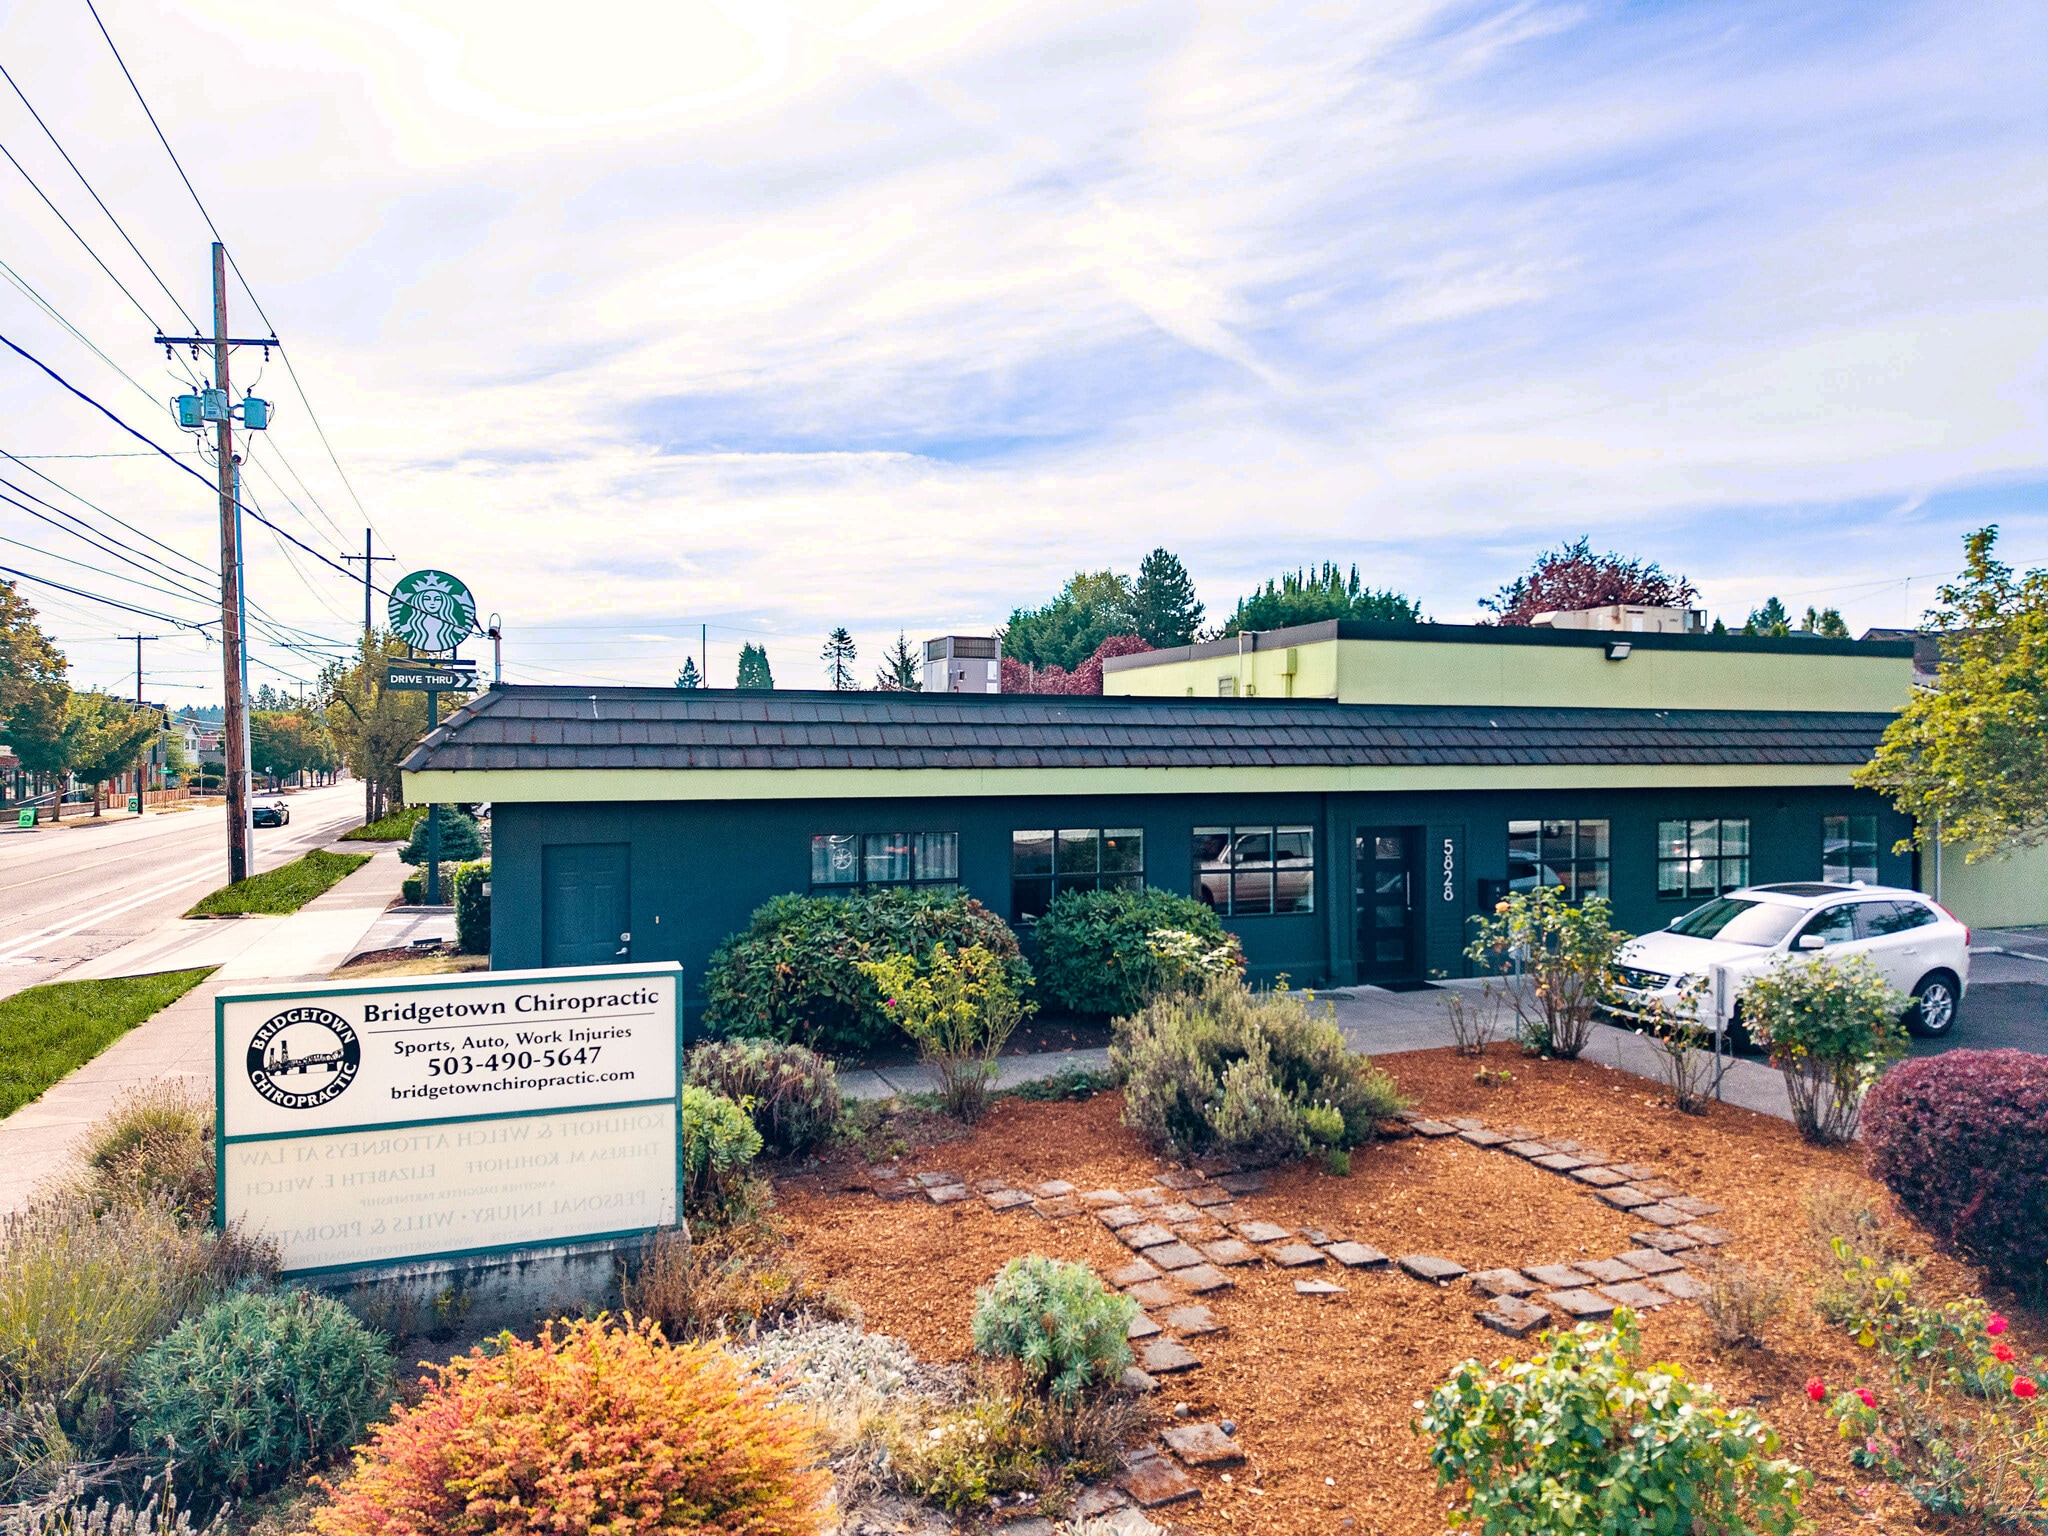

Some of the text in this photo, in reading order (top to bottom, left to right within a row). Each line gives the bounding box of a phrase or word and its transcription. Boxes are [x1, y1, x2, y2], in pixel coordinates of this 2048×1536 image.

[390, 675, 453, 684] DRIVE THRU
[1443, 838, 1454, 901] 5828
[364, 987, 659, 1024] Bridgetown Chiropractic
[251, 1009, 356, 1051] BRIDGETOWN
[394, 1026, 632, 1057] Sports, Auto, Work Injuries
[427, 1046, 602, 1077] 503-490-5647
[251, 1062, 357, 1108] CHIROPRACTIC
[391, 1071, 635, 1100] bridgetownchiropractic.com
